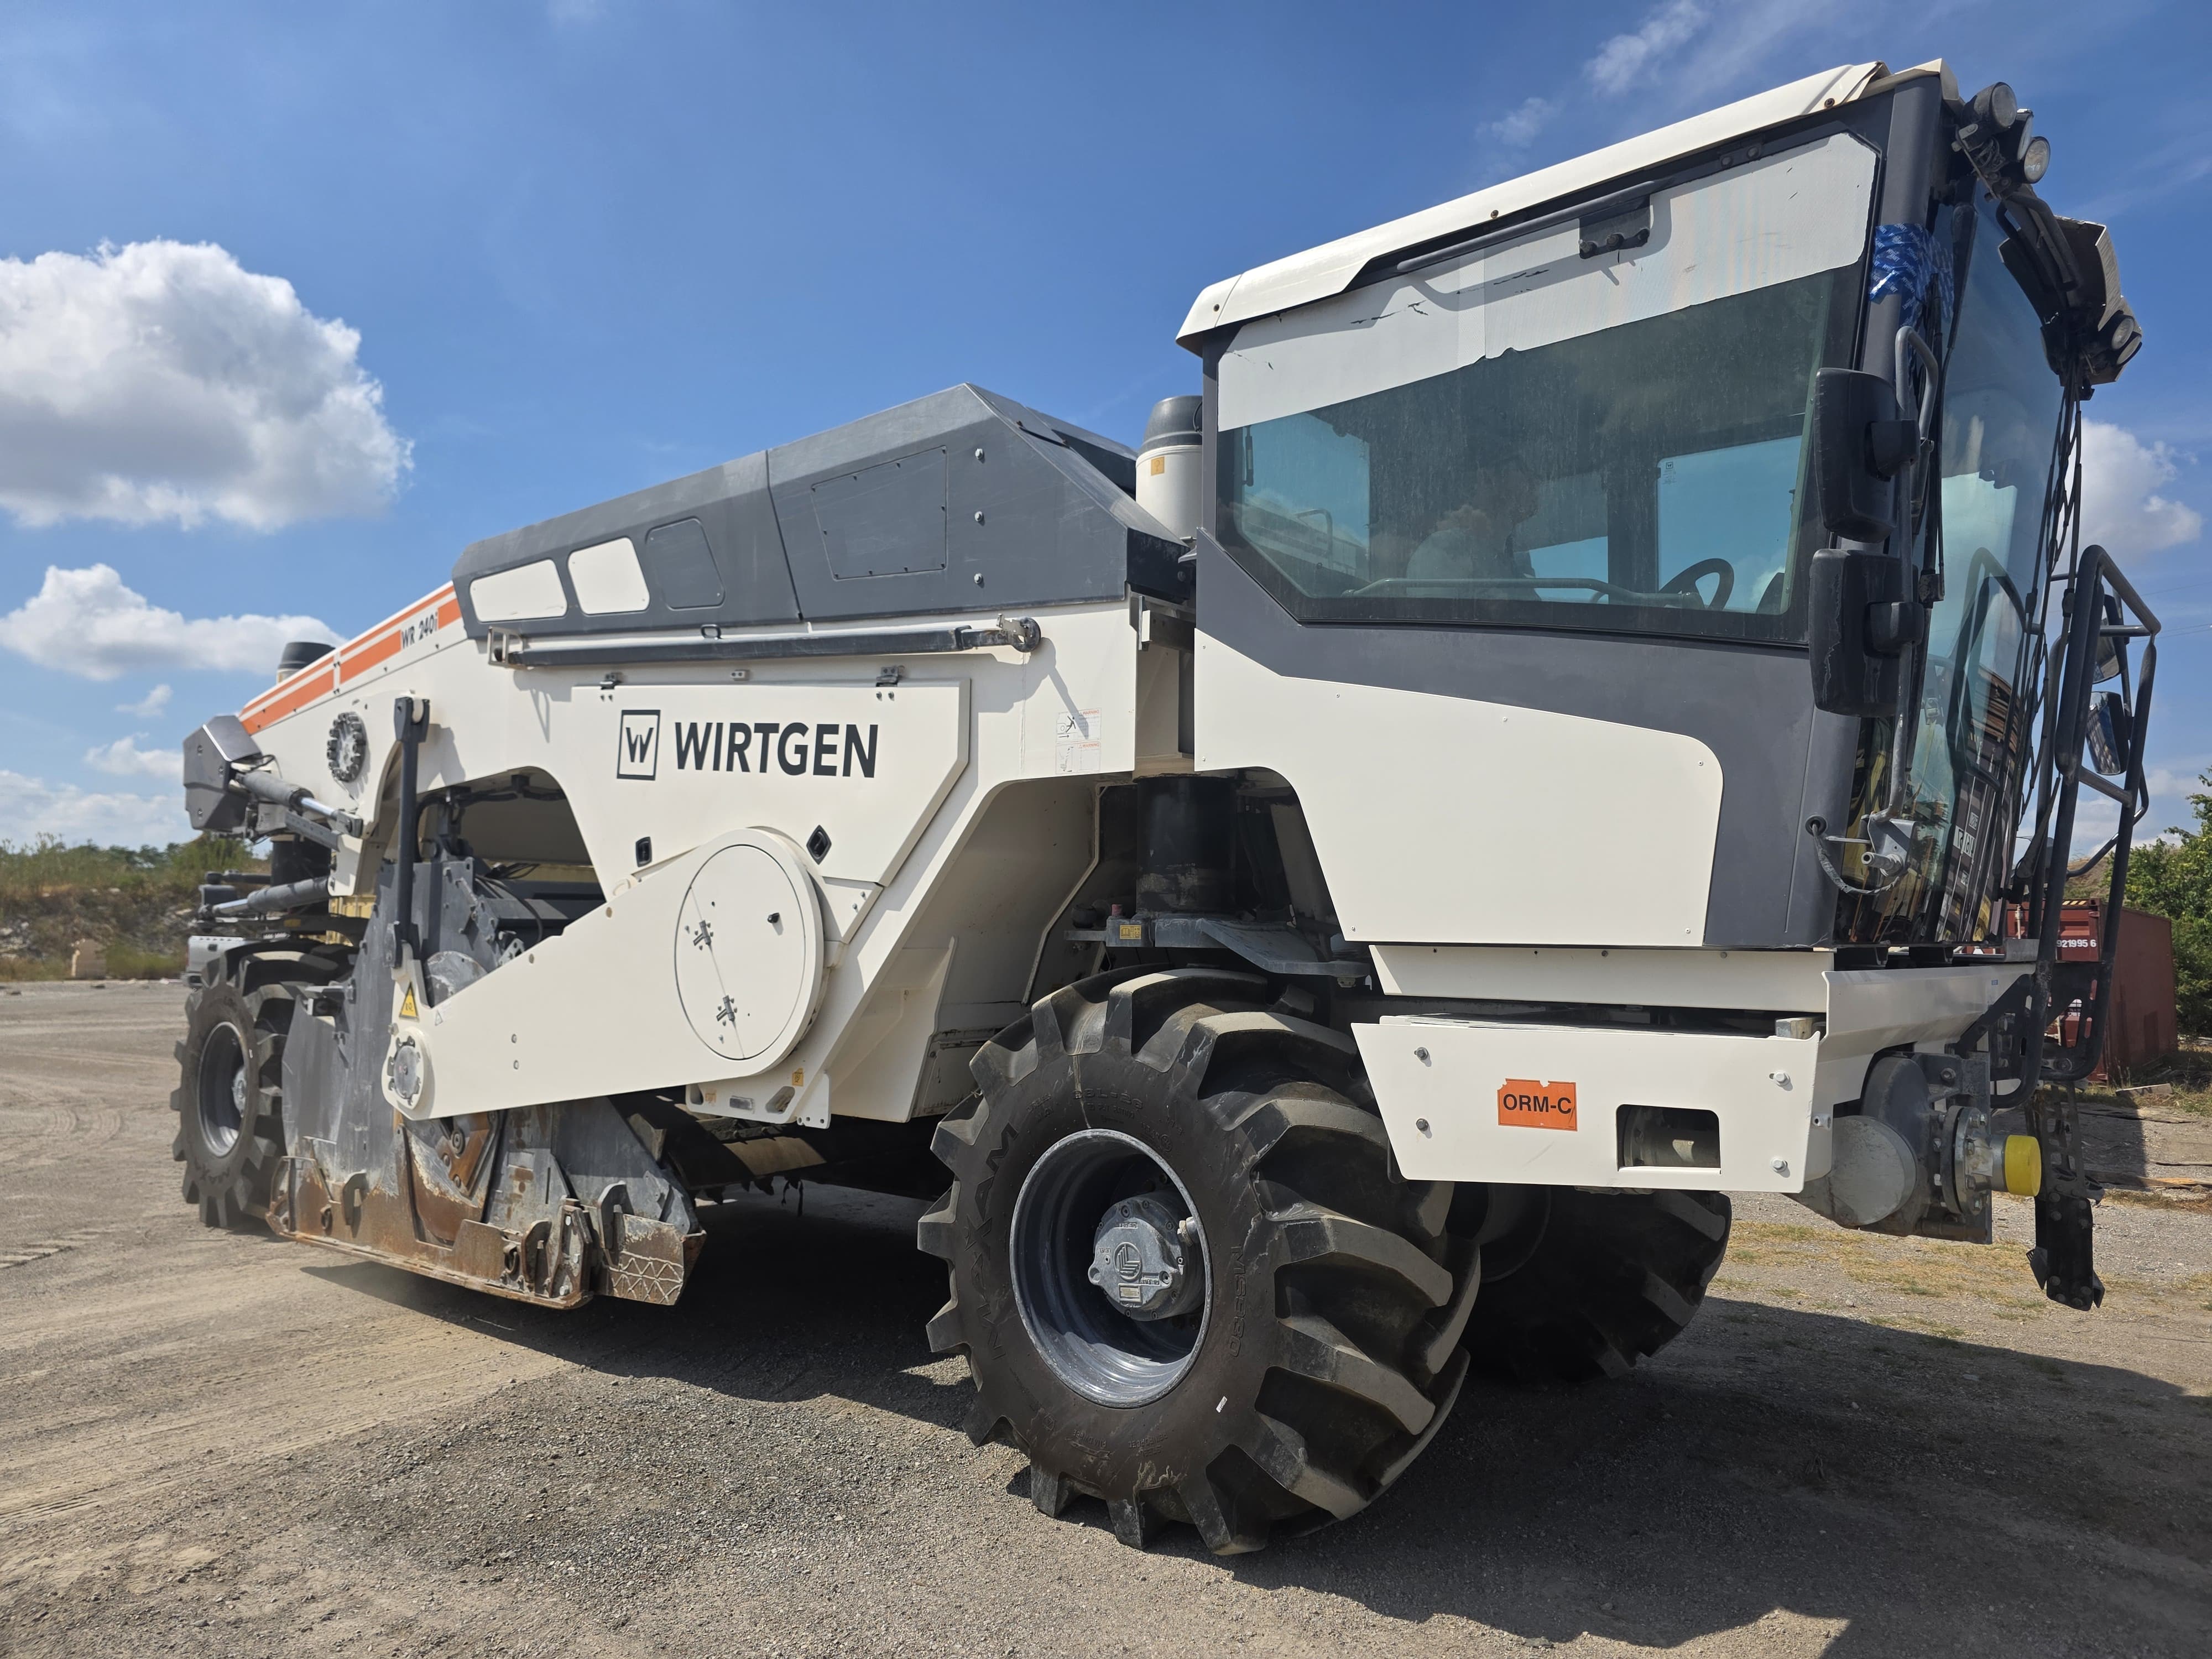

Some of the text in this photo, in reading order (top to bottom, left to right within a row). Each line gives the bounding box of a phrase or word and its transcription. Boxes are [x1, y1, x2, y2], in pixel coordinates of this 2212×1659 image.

[401, 625, 415, 649] WR
[625, 727, 654, 763] W
[675, 722, 879, 778] WIRTGEN
[2090, 939, 2097, 947] 6
[1503, 1093, 1572, 1114] ORM-C
